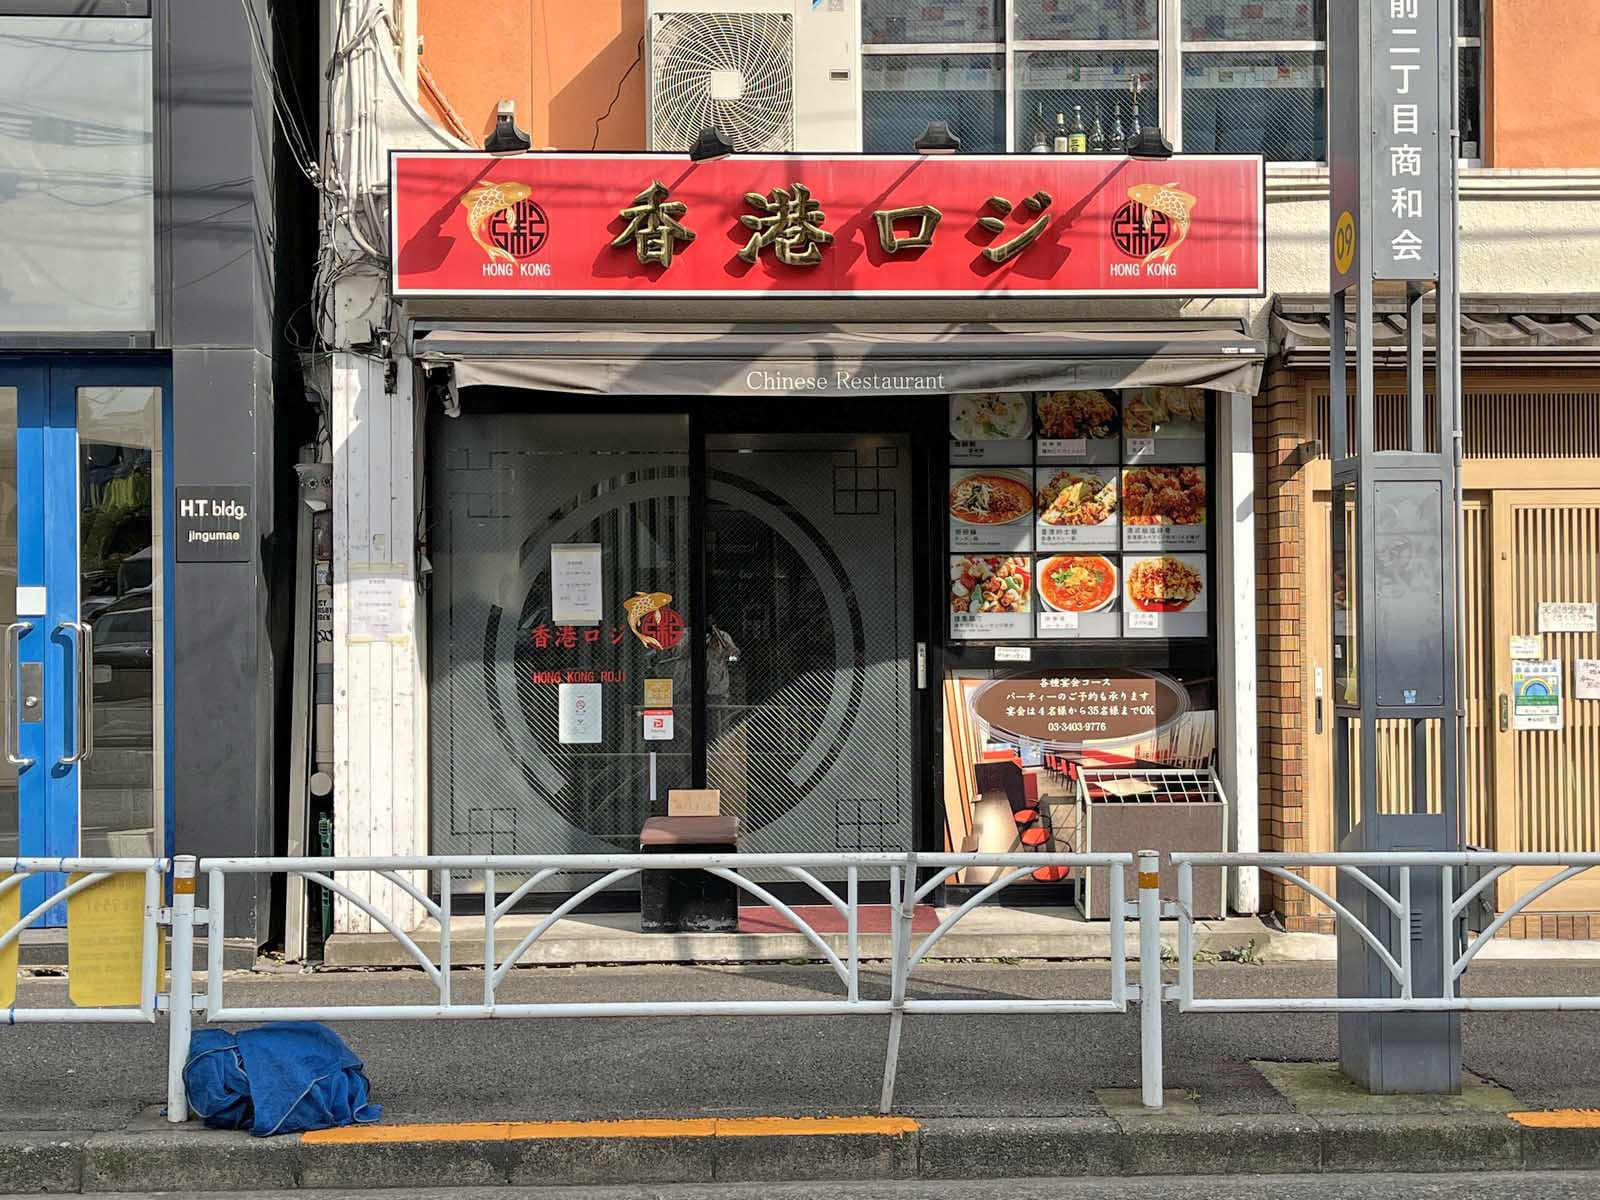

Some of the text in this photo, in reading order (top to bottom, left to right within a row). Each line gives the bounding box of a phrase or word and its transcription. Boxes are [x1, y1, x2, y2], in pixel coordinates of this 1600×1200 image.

[610, 180, 1052, 268] 香港ロジ
[1337, 222, 1353, 260] 09
[482, 263, 551, 277] HONG KONG
[1110, 263, 1177, 277] HONG KONG
[746, 370, 945, 390] Chinese Restaurant
[180, 499, 248, 520] H.T. bldg.
[188, 530, 240, 543] jingumae
[532, 623, 625, 649] 香港ロジ
[532, 671, 627, 684] HONG KONG ROJI
[1039, 677, 1111, 688] 各種宴会コース
[1006, 691, 1150, 702] パーティーのご予約も承ります
[1047, 721, 1107, 733] 03-3403-9776
